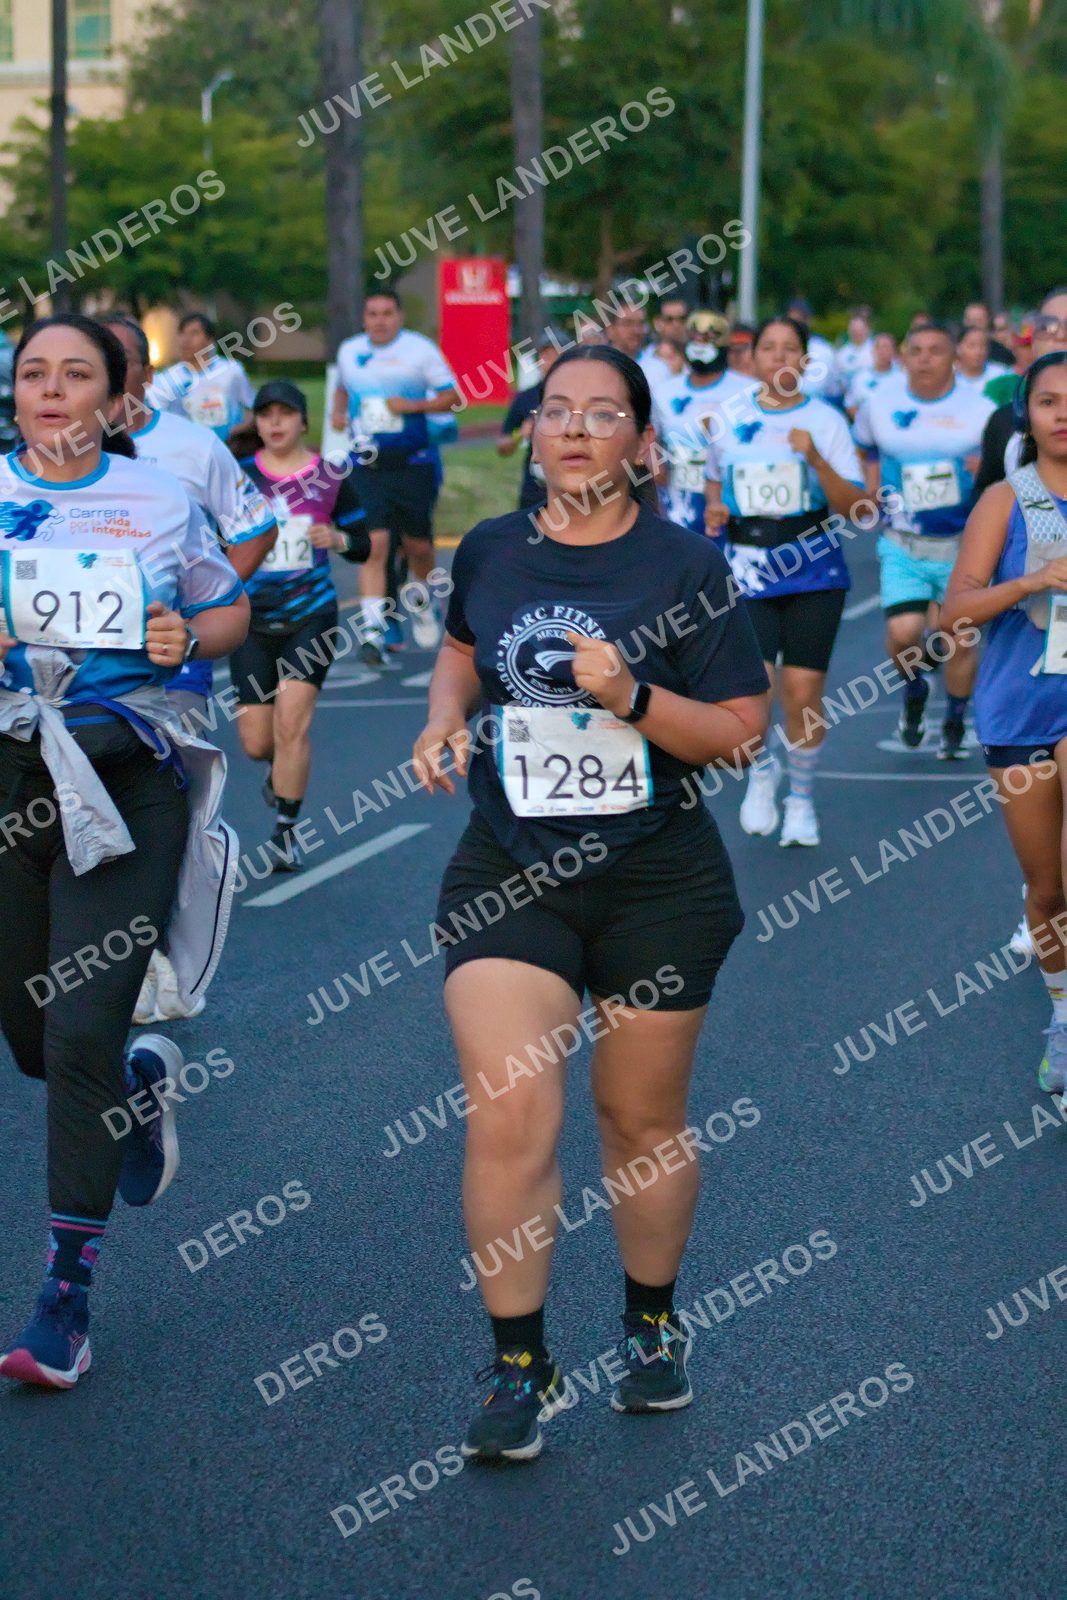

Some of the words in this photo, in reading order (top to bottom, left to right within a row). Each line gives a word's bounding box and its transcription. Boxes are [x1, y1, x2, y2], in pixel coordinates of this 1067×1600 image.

[69, 507, 129, 519] Carrera
[746, 483, 791, 511] 190
[32, 590, 123, 634] 912
[498, 606, 548, 649] MARC
[553, 605, 607, 640] FITNE
[514, 754, 643, 800] 1284
